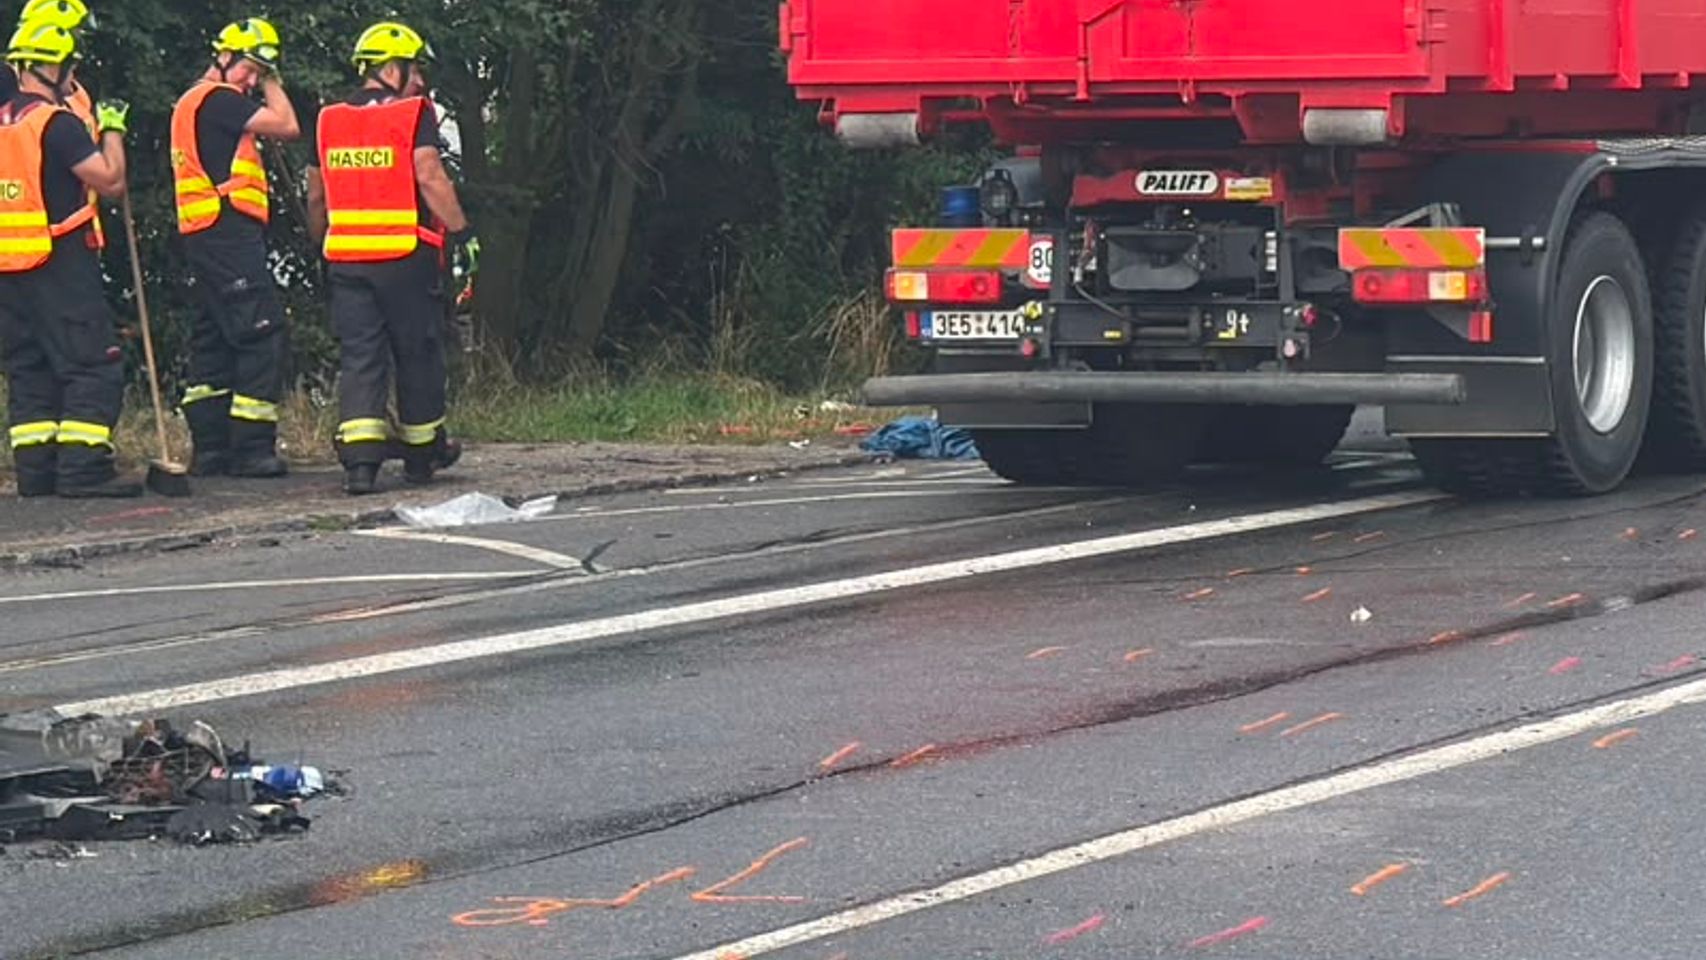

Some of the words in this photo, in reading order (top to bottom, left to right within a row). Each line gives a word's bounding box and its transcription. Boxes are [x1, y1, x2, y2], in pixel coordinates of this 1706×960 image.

[1143, 174, 1210, 191] PALIFT
[936, 313, 972, 335] 3E5
[986, 313, 1025, 335] 414
